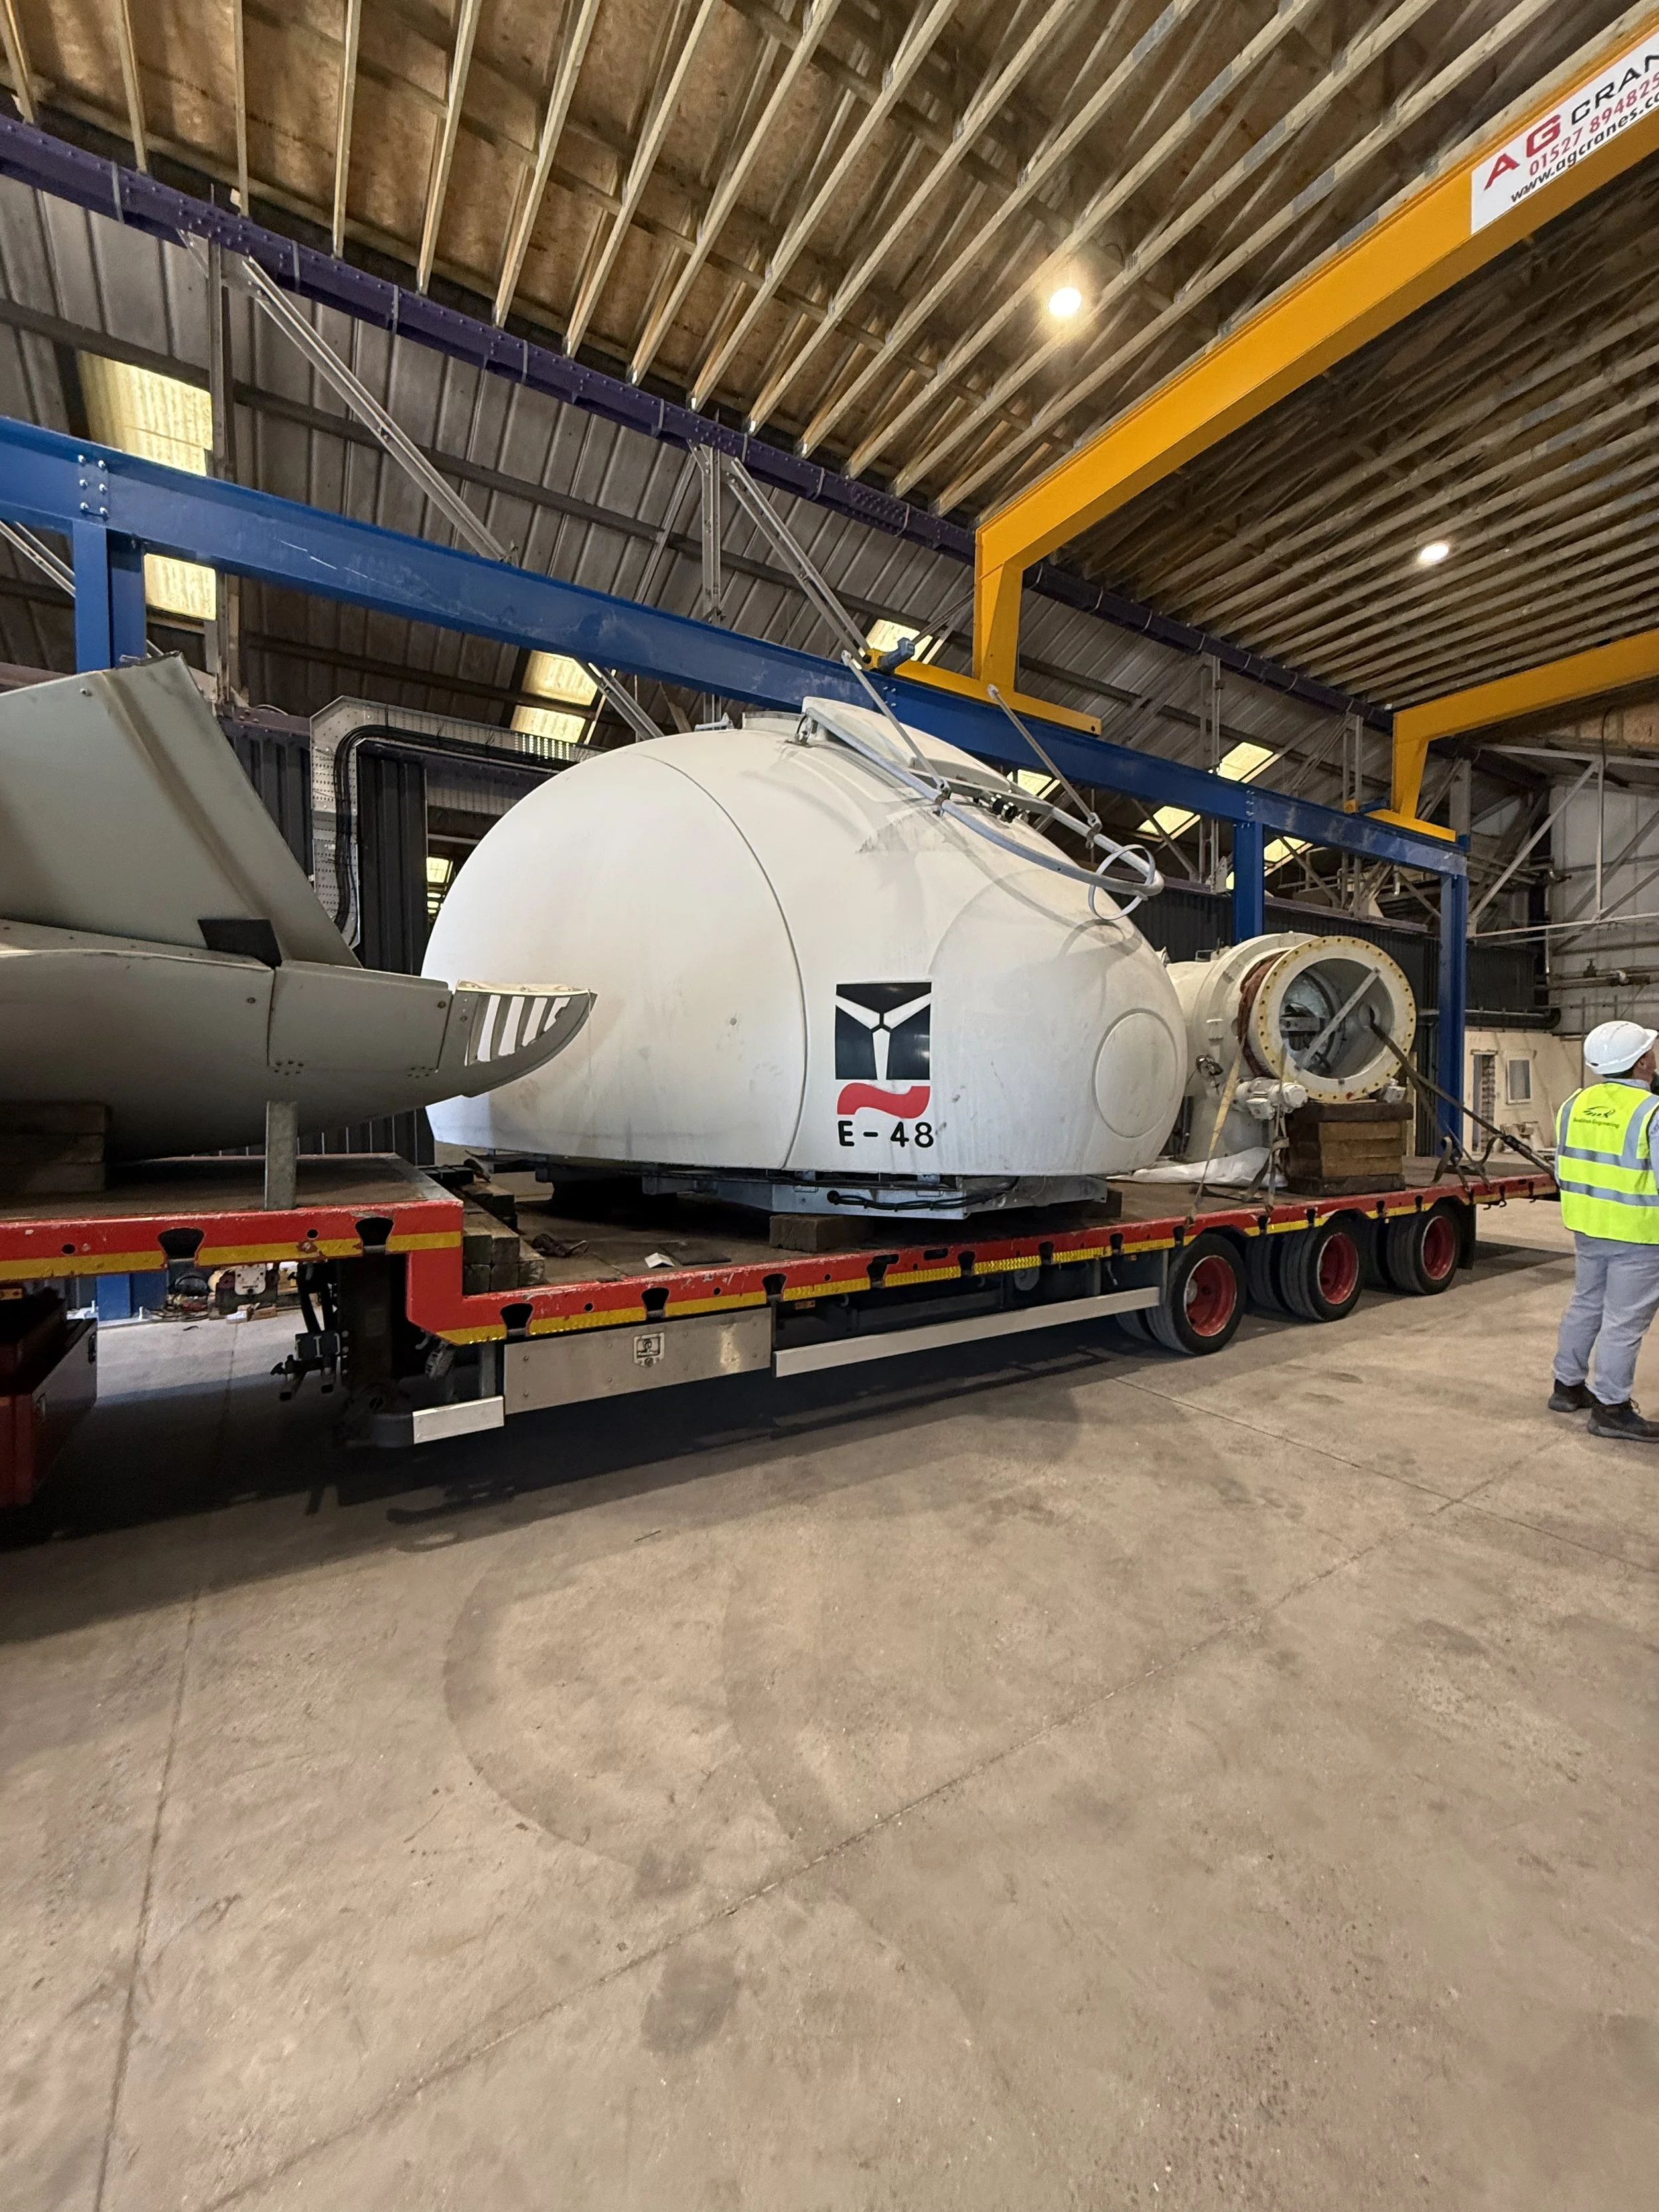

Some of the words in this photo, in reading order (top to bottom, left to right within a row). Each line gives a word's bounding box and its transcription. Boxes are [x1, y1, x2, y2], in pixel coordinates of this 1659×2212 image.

[1484, 153, 1520, 191] A
[1526, 114, 1561, 158] G
[1529, 127, 1584, 177] 01527
